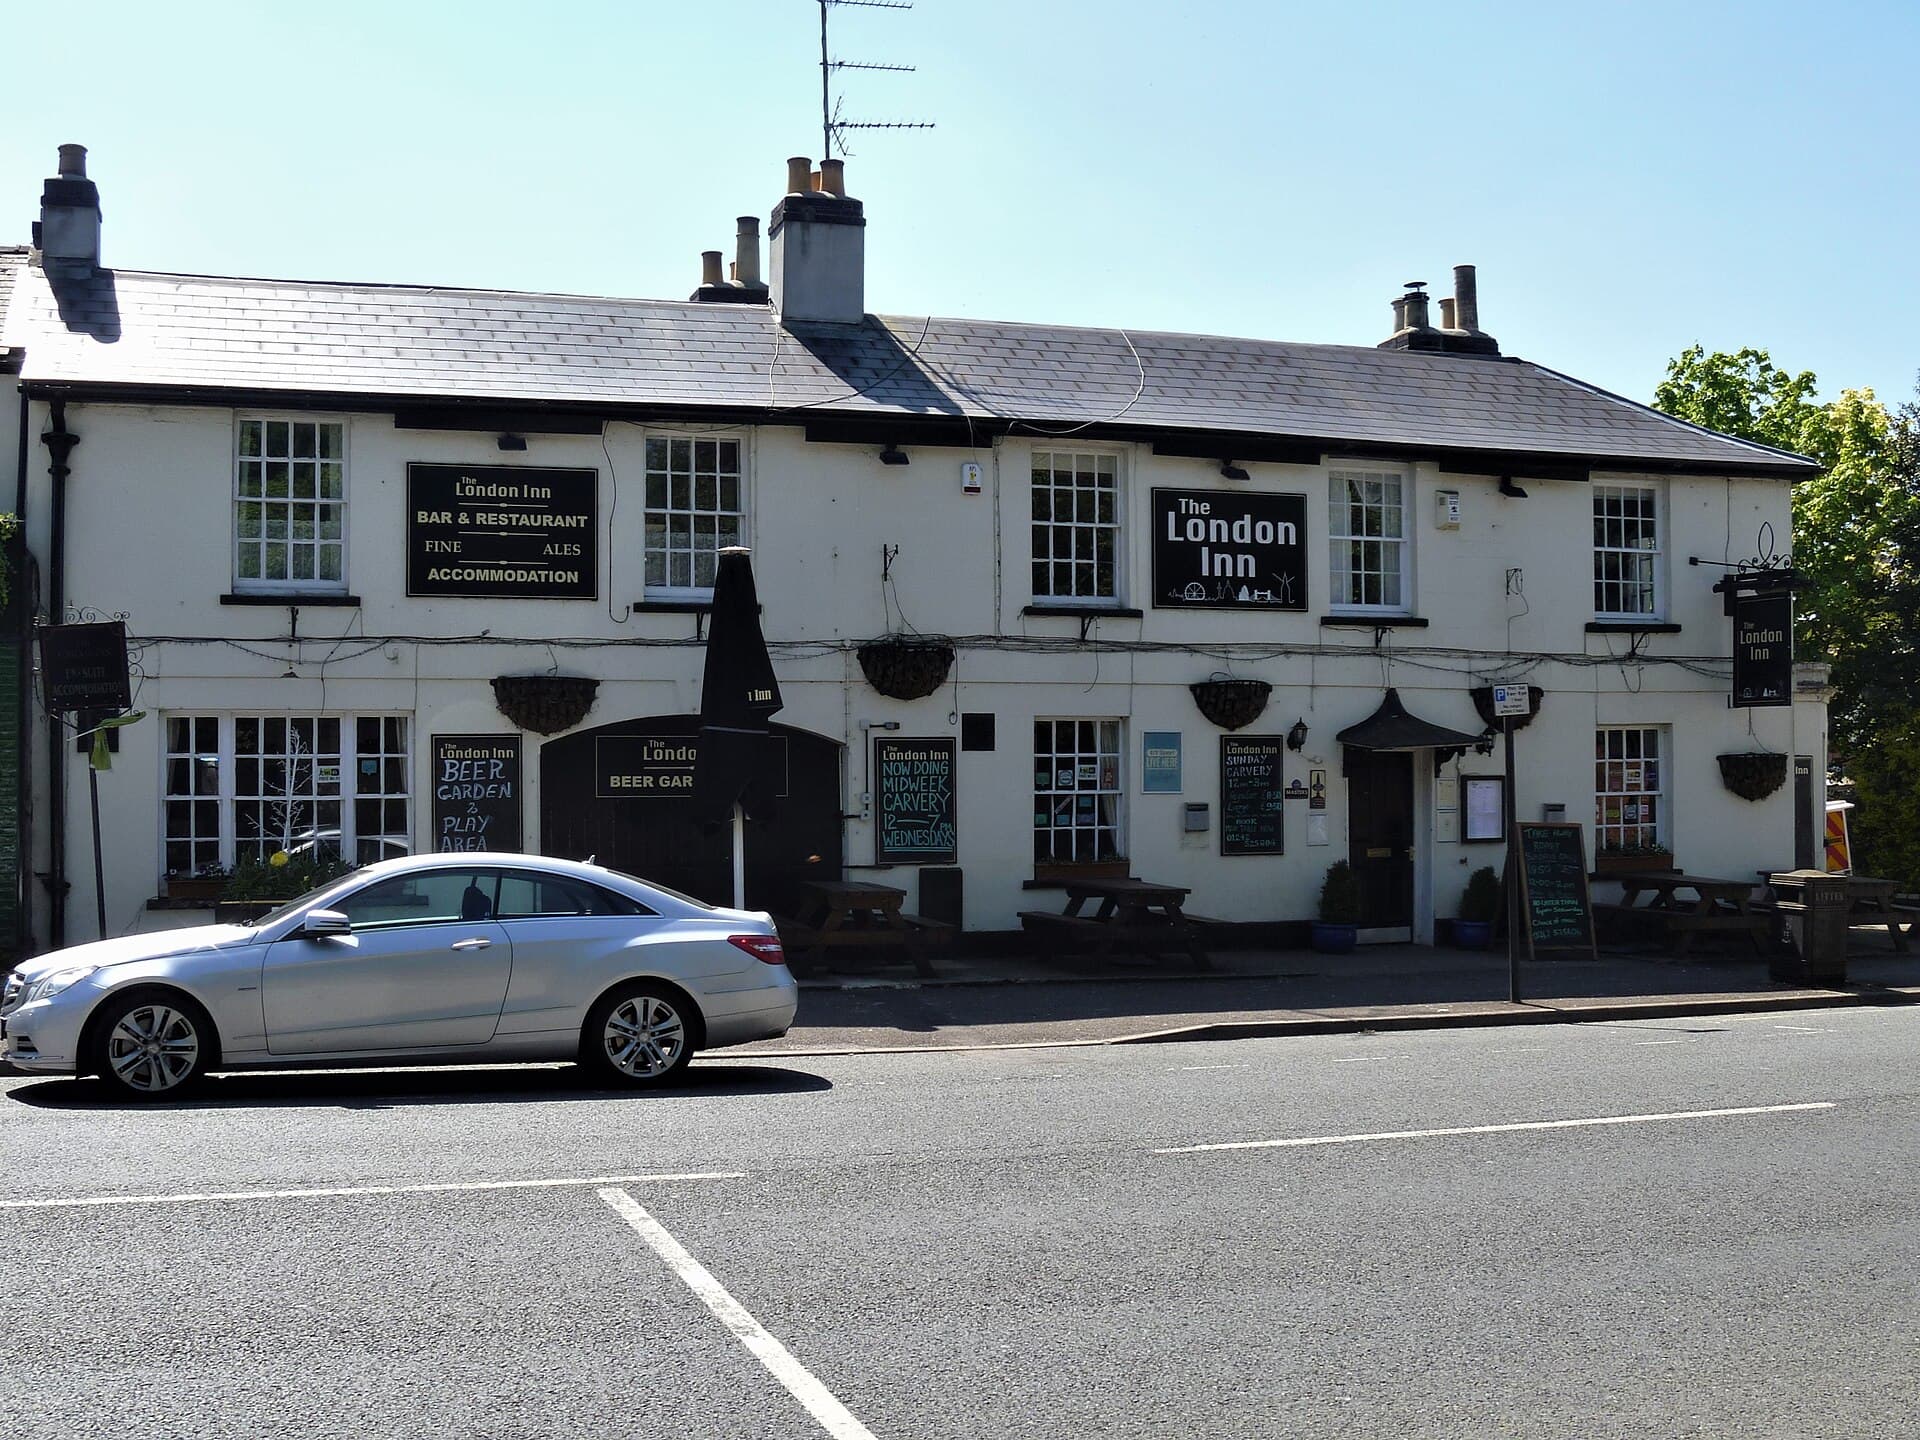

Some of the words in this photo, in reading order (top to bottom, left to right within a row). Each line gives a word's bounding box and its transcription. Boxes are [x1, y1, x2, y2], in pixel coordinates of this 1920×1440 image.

[461, 476, 477, 485] The
[455, 482, 518, 498] London
[523, 484, 551, 499] Inn
[1178, 498, 1210, 515] The
[417, 511, 453, 524] BAR
[458, 512, 470, 524] &
[476, 512, 588, 527] RESTAURANT
[1167, 511, 1296, 545] London
[425, 540, 462, 553] FINE
[543, 544, 581, 556] ALES
[1201, 546, 1256, 577] Inn
[427, 568, 579, 583] ACCOMMODATION
[1740, 628, 1783, 645] London
[1750, 646, 1769, 660] Inn
[754, 689, 772, 701] Inn
[648, 739, 665, 748] The
[1227, 745, 1260, 754] London
[1262, 745, 1277, 754] Inn
[440, 747, 489, 759] London
[493, 747, 514, 759] Inn
[643, 745, 697, 760] Londo
[883, 750, 927, 761] London
[930, 750, 949, 760] Inn
[1226, 755, 1267, 766] SUNDAY
[441, 759, 505, 782] BEER
[883, 761, 911, 776] NOW
[914, 761, 949, 775] DOING
[1226, 765, 1272, 777] CARVERY
[1795, 766, 1809, 775] Inn
[610, 775, 654, 788] BEER
[659, 775, 694, 788] GAR
[883, 776, 950, 792] MIDWEEK
[437, 782, 512, 800] GARDEN
[883, 792, 951, 813] CARVERY
[443, 815, 491, 834] PLAY
[441, 835, 488, 852] AREA
[882, 830, 955, 847] WEDNESDAYS
